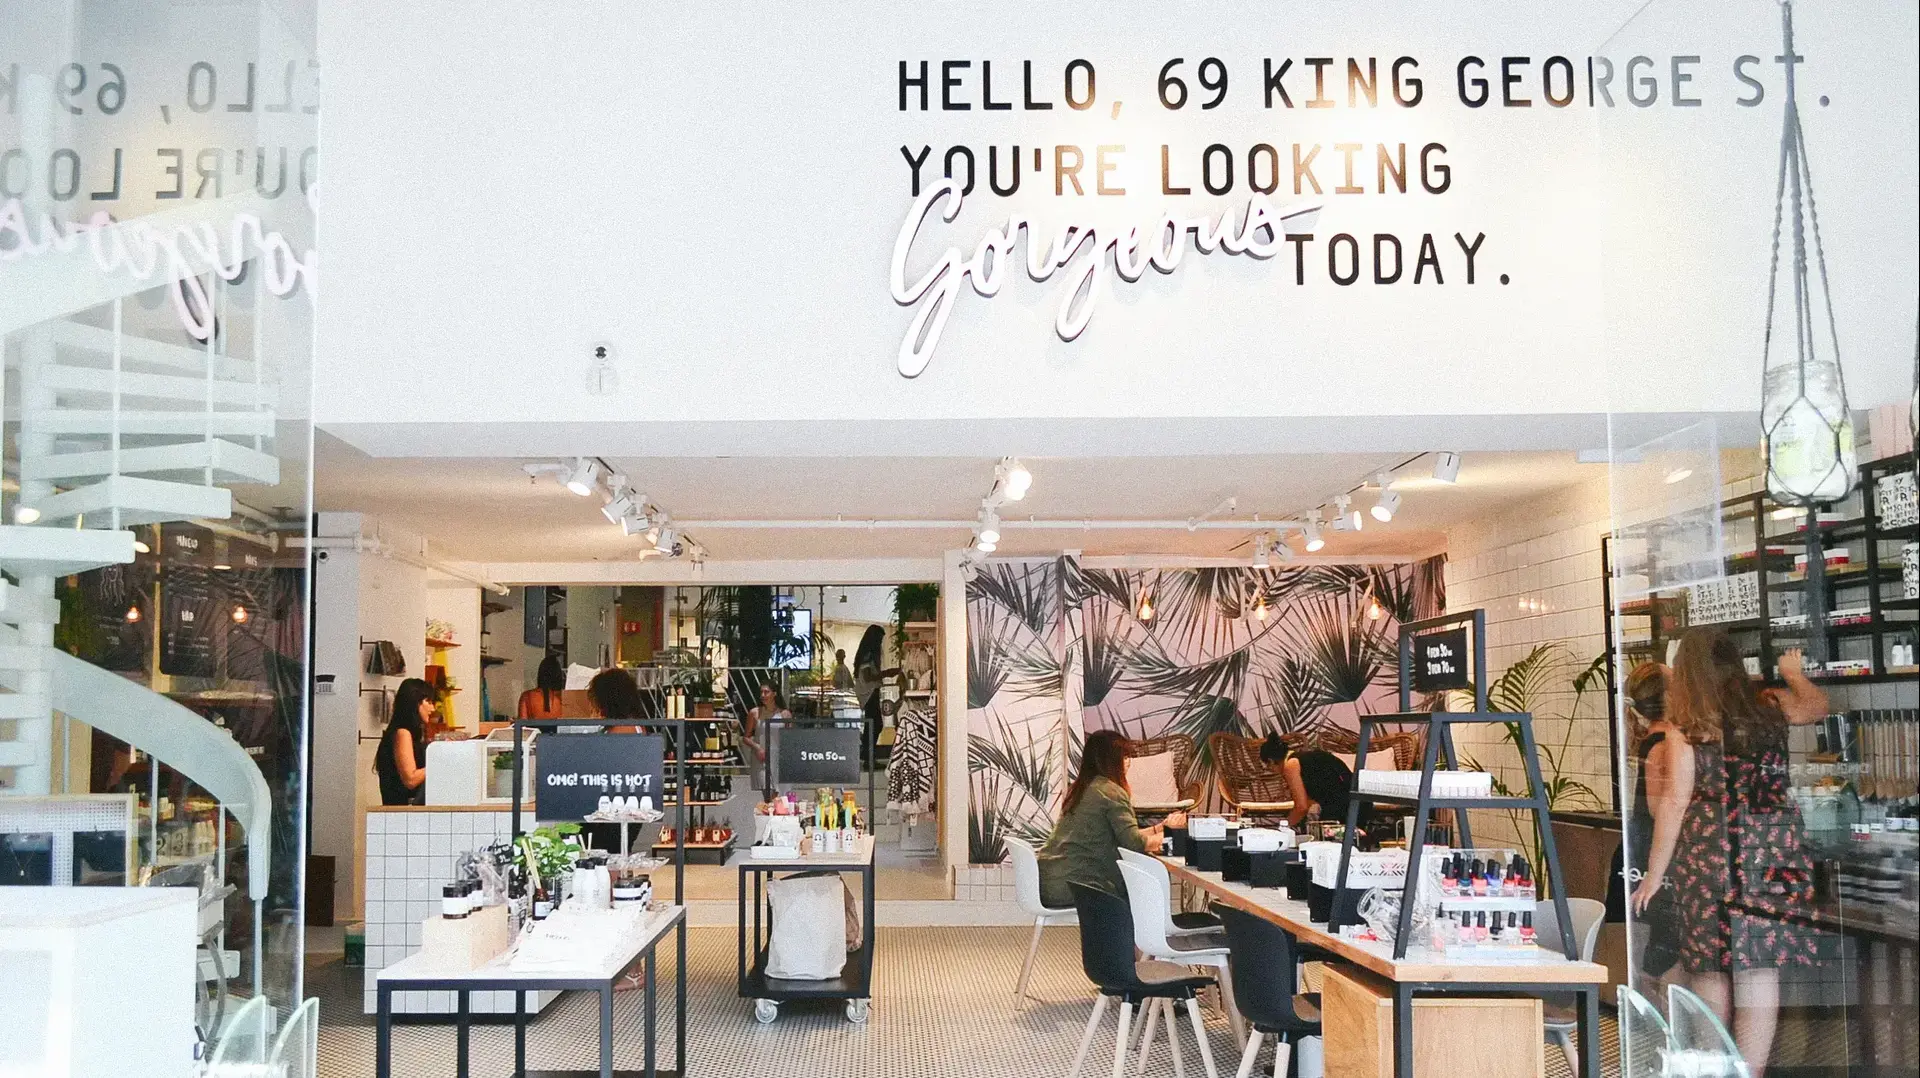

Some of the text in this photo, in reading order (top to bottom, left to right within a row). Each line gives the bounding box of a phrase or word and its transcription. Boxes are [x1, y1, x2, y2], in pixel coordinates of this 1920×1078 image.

[898, 53, 1831, 120] HELLO, 69 KING GEORGE ST.
[899, 142, 1452, 197] YOU'RE LOOKING
[889, 177, 1324, 379] Gorgeous
[1287, 231, 1511, 286] TODAY.
[546, 772, 653, 787] OMG! THIS IS HOT
[801, 750, 807, 761] 3
[808, 752, 825, 761] FOR
